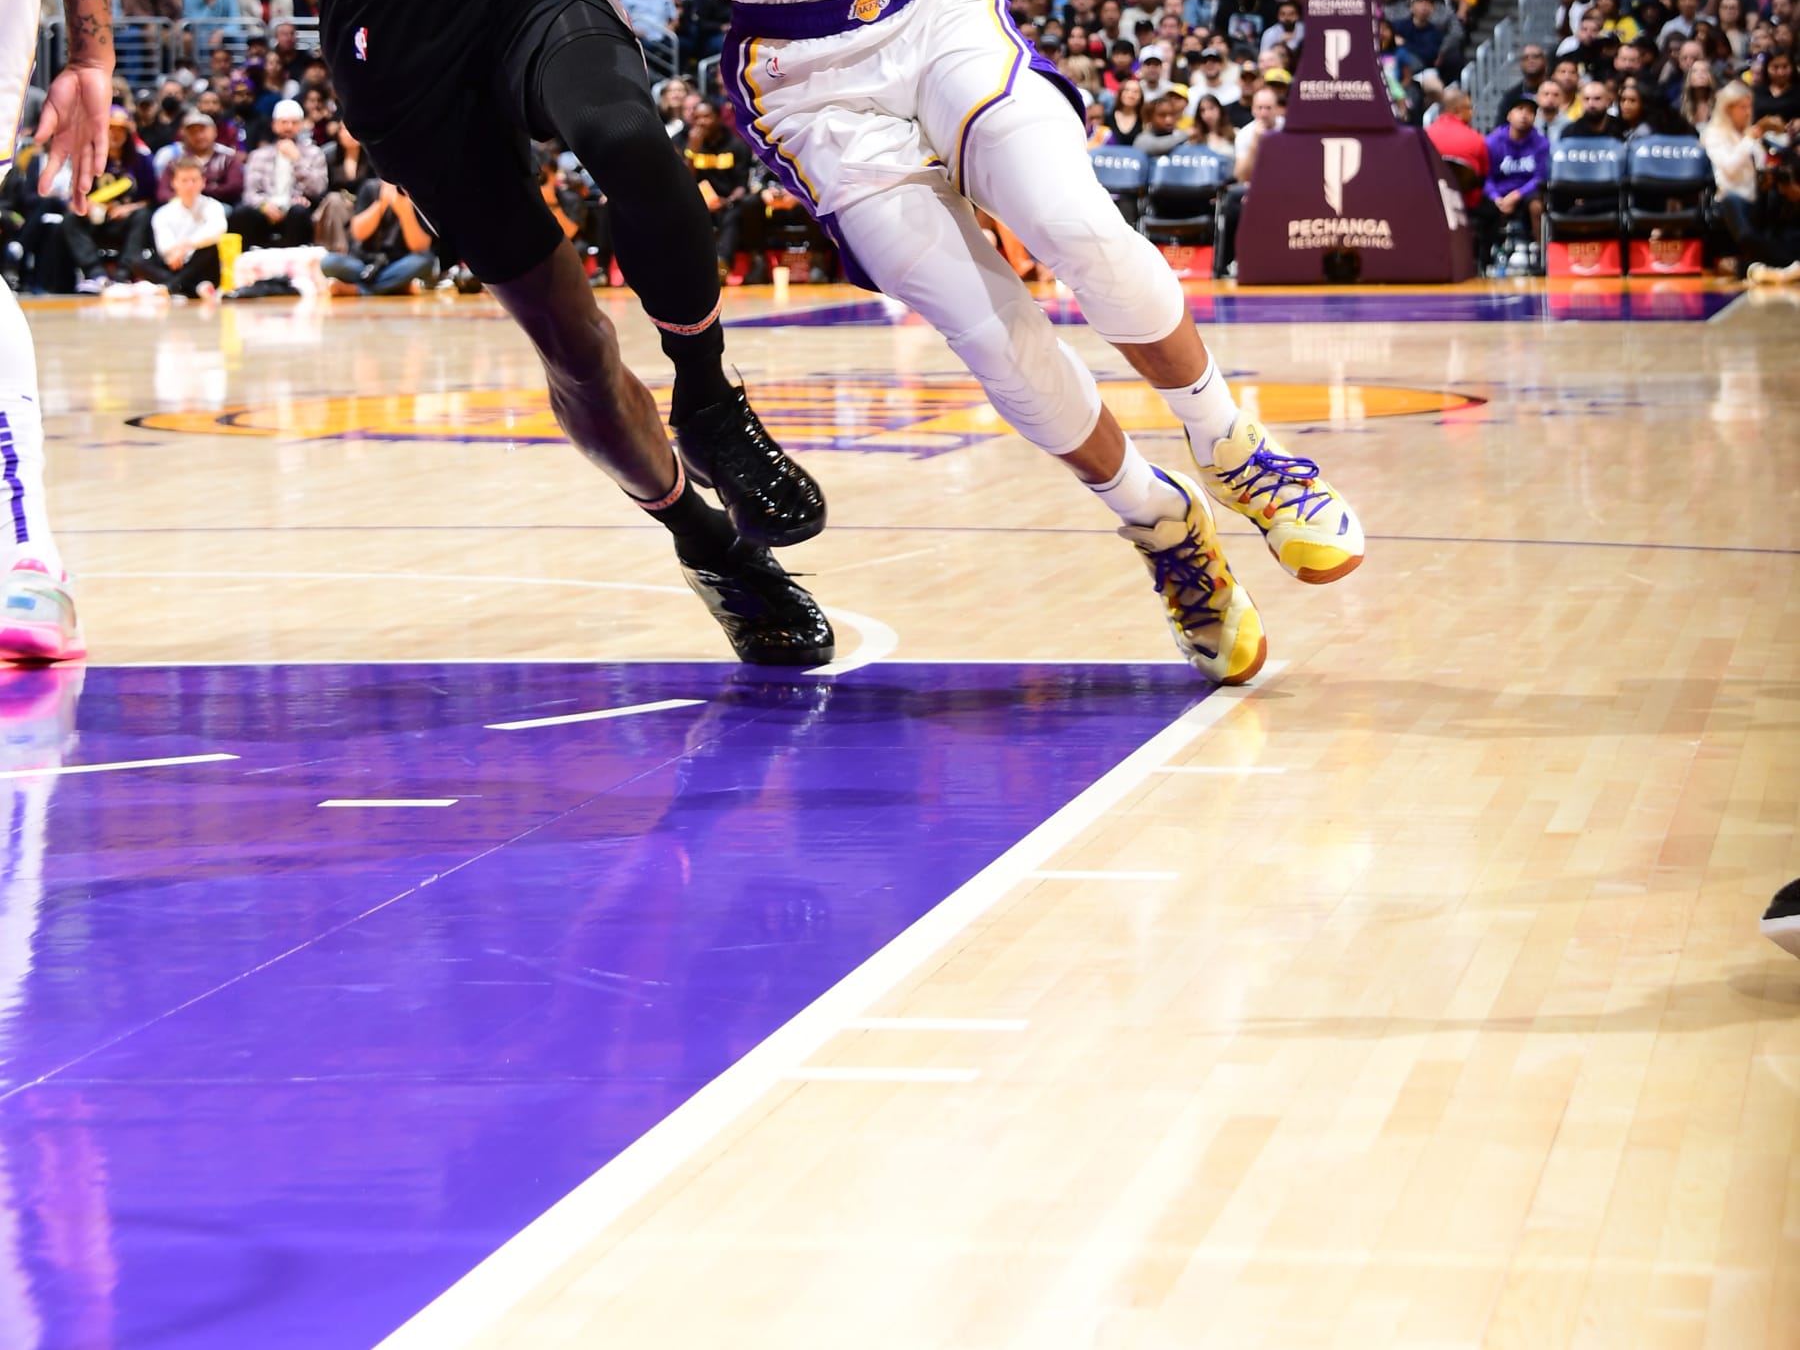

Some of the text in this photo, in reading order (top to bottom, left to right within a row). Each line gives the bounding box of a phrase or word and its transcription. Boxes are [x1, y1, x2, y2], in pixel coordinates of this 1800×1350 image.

[1300, 81, 1374, 93] PECHANGA
[1568, 149, 1617, 163] DELTA
[1651, 145, 1700, 159] DELTA
[1094, 155, 1140, 170] DELTA
[1171, 155, 1218, 168] DELTA
[1288, 218, 1391, 236] PECHANGA
[1288, 233, 1393, 249] RESORT CASINO
